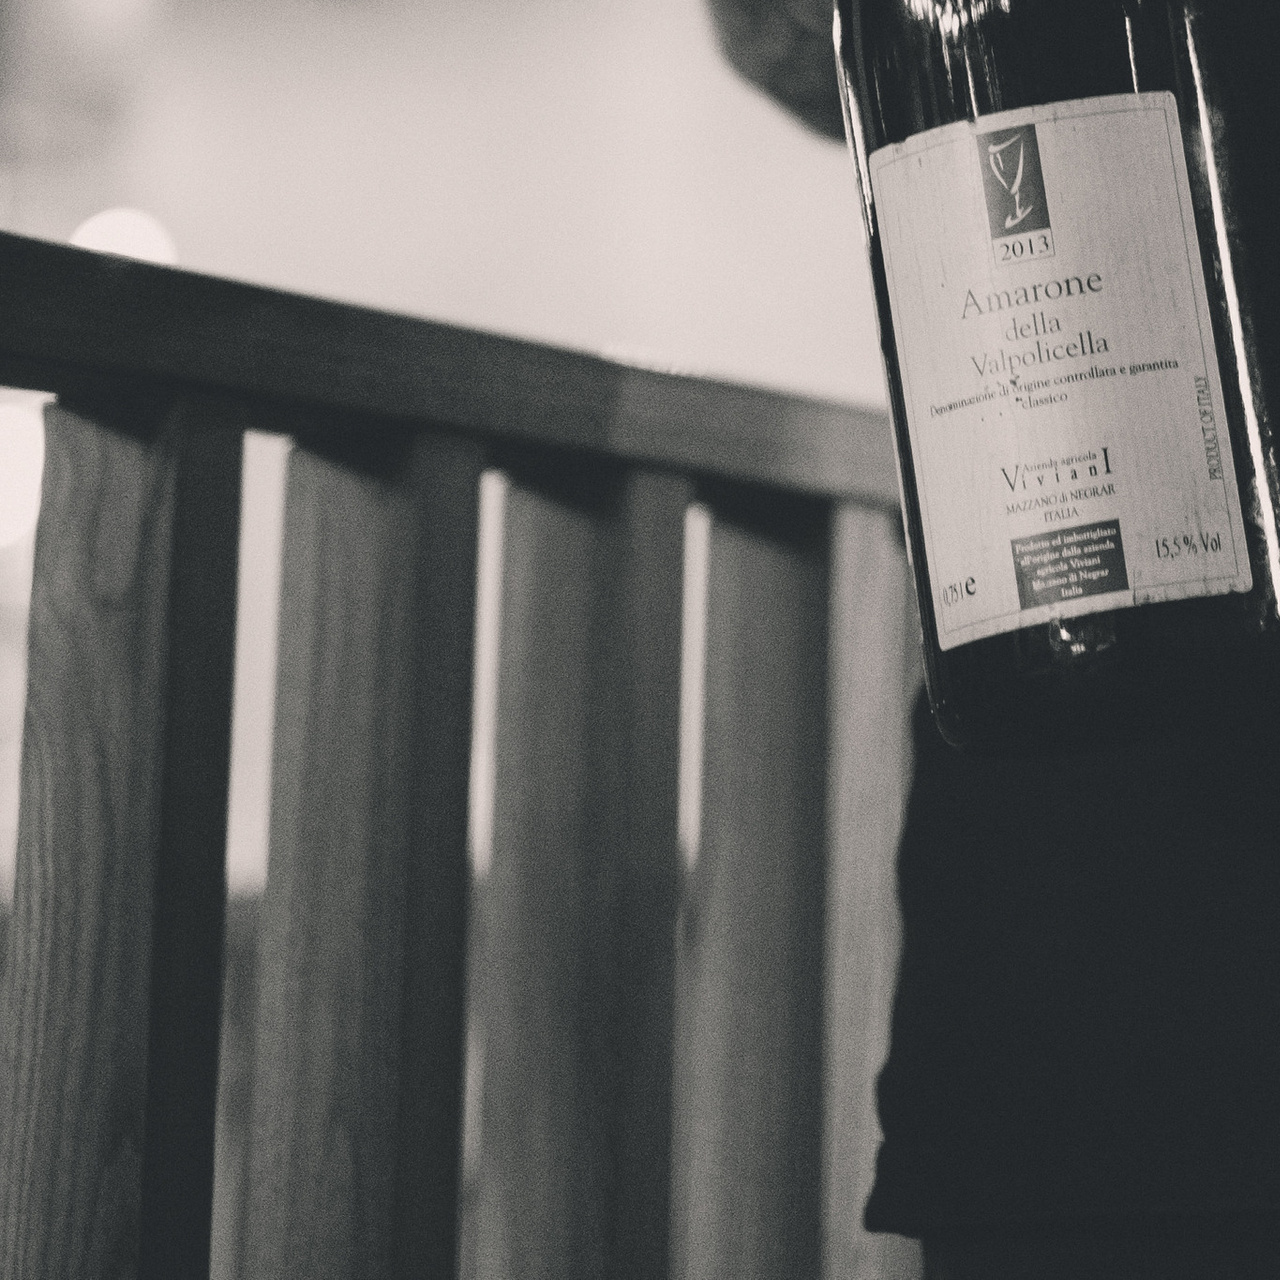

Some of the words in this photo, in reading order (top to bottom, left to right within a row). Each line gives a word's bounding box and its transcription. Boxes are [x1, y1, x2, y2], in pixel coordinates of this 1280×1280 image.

[1001, 235, 1050, 261] 2013
[962, 272, 1103, 319] Amarone
[1006, 311, 1061, 342] della
[971, 330, 1109, 377] Valpolicella
[930, 389, 996, 417] Denominazione
[1012, 378, 1050, 396] origine
[1053, 366, 1117, 385] controllata
[1119, 365, 1126, 374] e
[1129, 357, 1179, 377] garantita
[1021, 391, 1068, 410] classico
[1194, 376, 1211, 407] ITALY
[1199, 408, 1213, 424] OF
[1061, 450, 1097, 466] agricola
[1202, 425, 1222, 481] PRODUCT
[1006, 494, 1058, 515] MAZZANO
[1060, 492, 1068, 503] di
[1070, 483, 1116, 501] NEGRAR
[1044, 506, 1080, 522] ITALIA
[1200, 531, 1222, 553] Vol
[1070, 555, 1100, 569] Viviani
